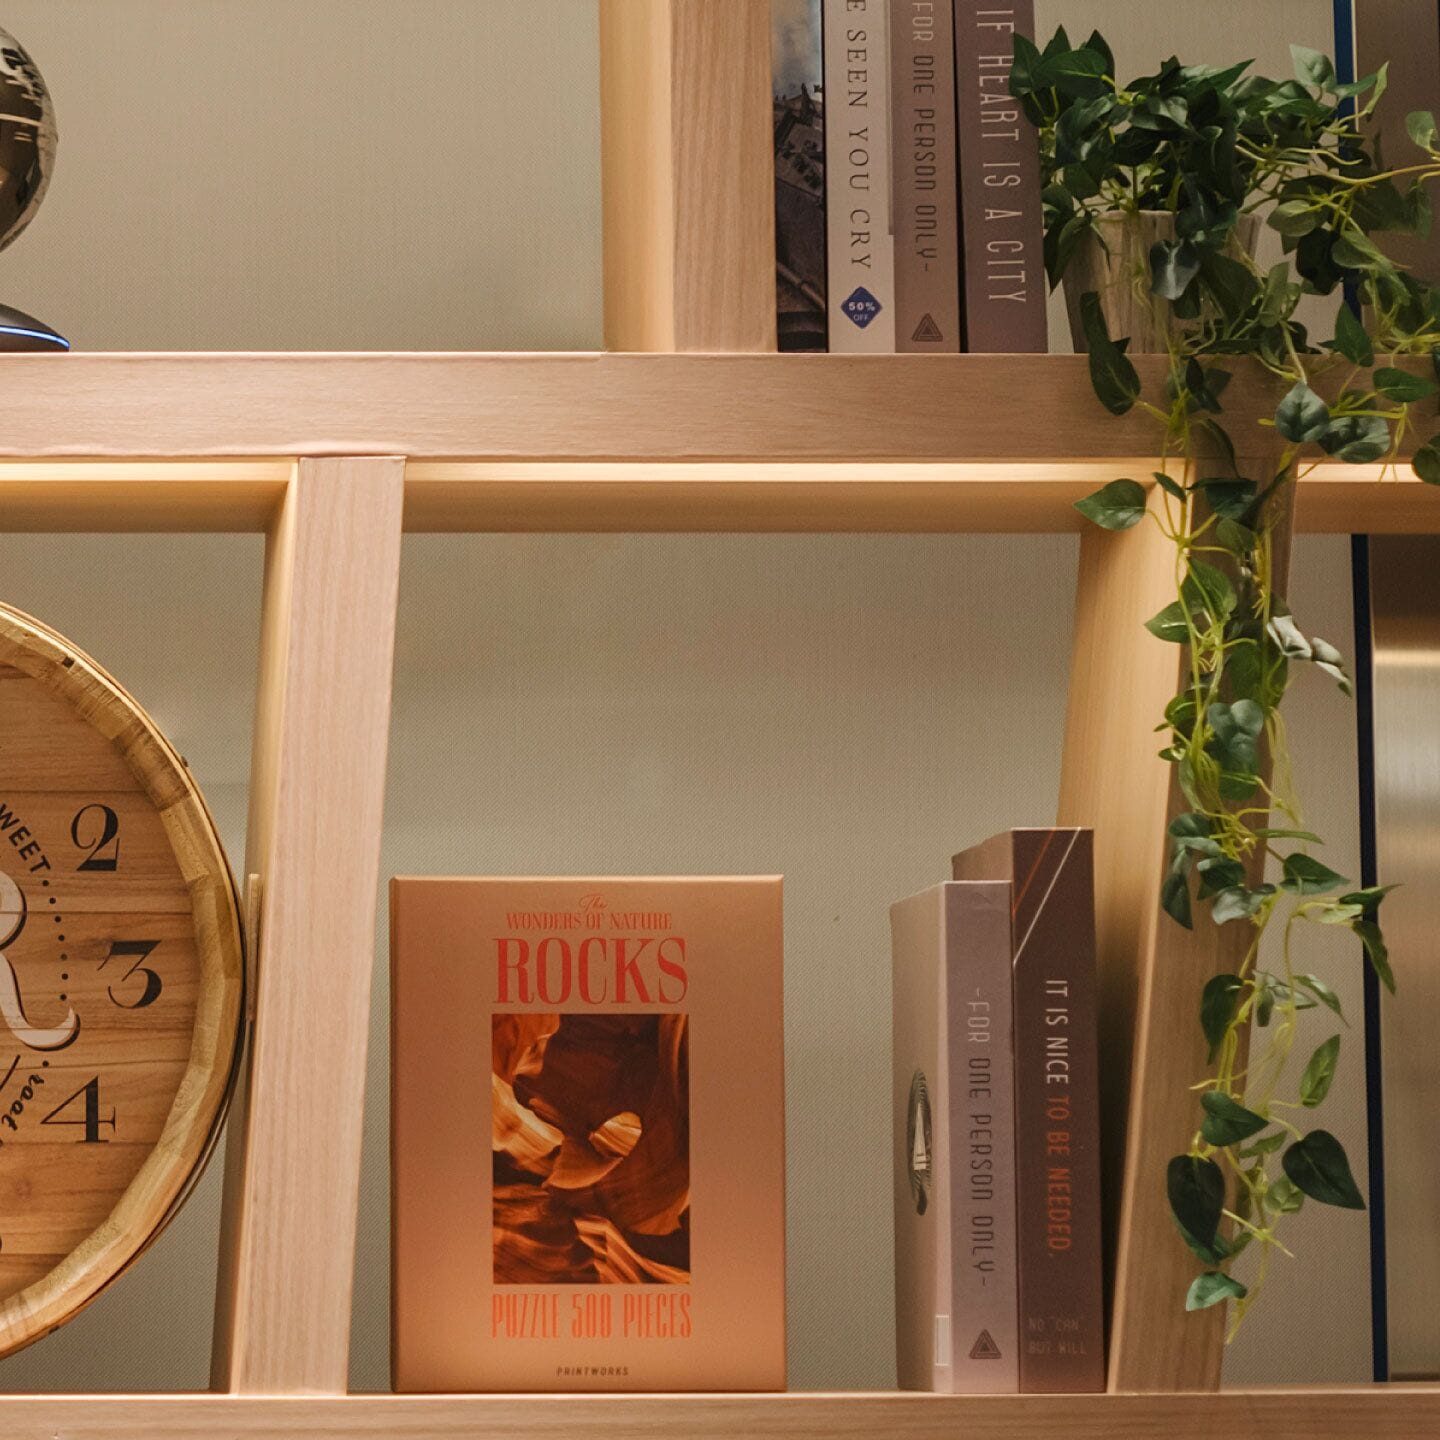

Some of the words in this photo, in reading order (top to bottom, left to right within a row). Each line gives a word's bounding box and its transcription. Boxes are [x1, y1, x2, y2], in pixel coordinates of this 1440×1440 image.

[976, 10, 1014, 33] IF
[847, 29, 868, 108] SEEN
[913, 55, 935, 94] ONE
[978, 55, 1020, 140] HEART
[848, 127, 870, 192] YOU
[913, 109, 936, 191] PERSON
[983, 162, 1021, 188] IS
[985, 208, 1023, 221] A
[850, 209, 871, 269] CRY
[987, 240, 1026, 303] CITY
[848, 301, 876, 312] 50%
[70, 803, 120, 872] 2
[506, 911, 582, 930] WONDERS
[586, 911, 604, 930] OF
[610, 911, 672, 930] NATURE
[97, 940, 163, 1009] 3
[491, 937, 689, 1005] ROCKS
[1045, 979, 1068, 998] IT
[1045, 1008, 1069, 1026] IS
[969, 1057, 991, 1099] ONE
[1046, 1037, 1069, 1084] NICE
[1, 1073, 45, 1132] root
[40, 1075, 117, 1144] 4
[1047, 1096, 1070, 1121] TO
[969, 1113, 993, 1200] PERSON
[1048, 1131, 1070, 1156] BE
[491, 1292, 561, 1338] PUZZLE
[572, 1292, 612, 1338] 500
[623, 1292, 692, 1338] PIECES
[556, 1366, 629, 1377] PRINTWORKS
